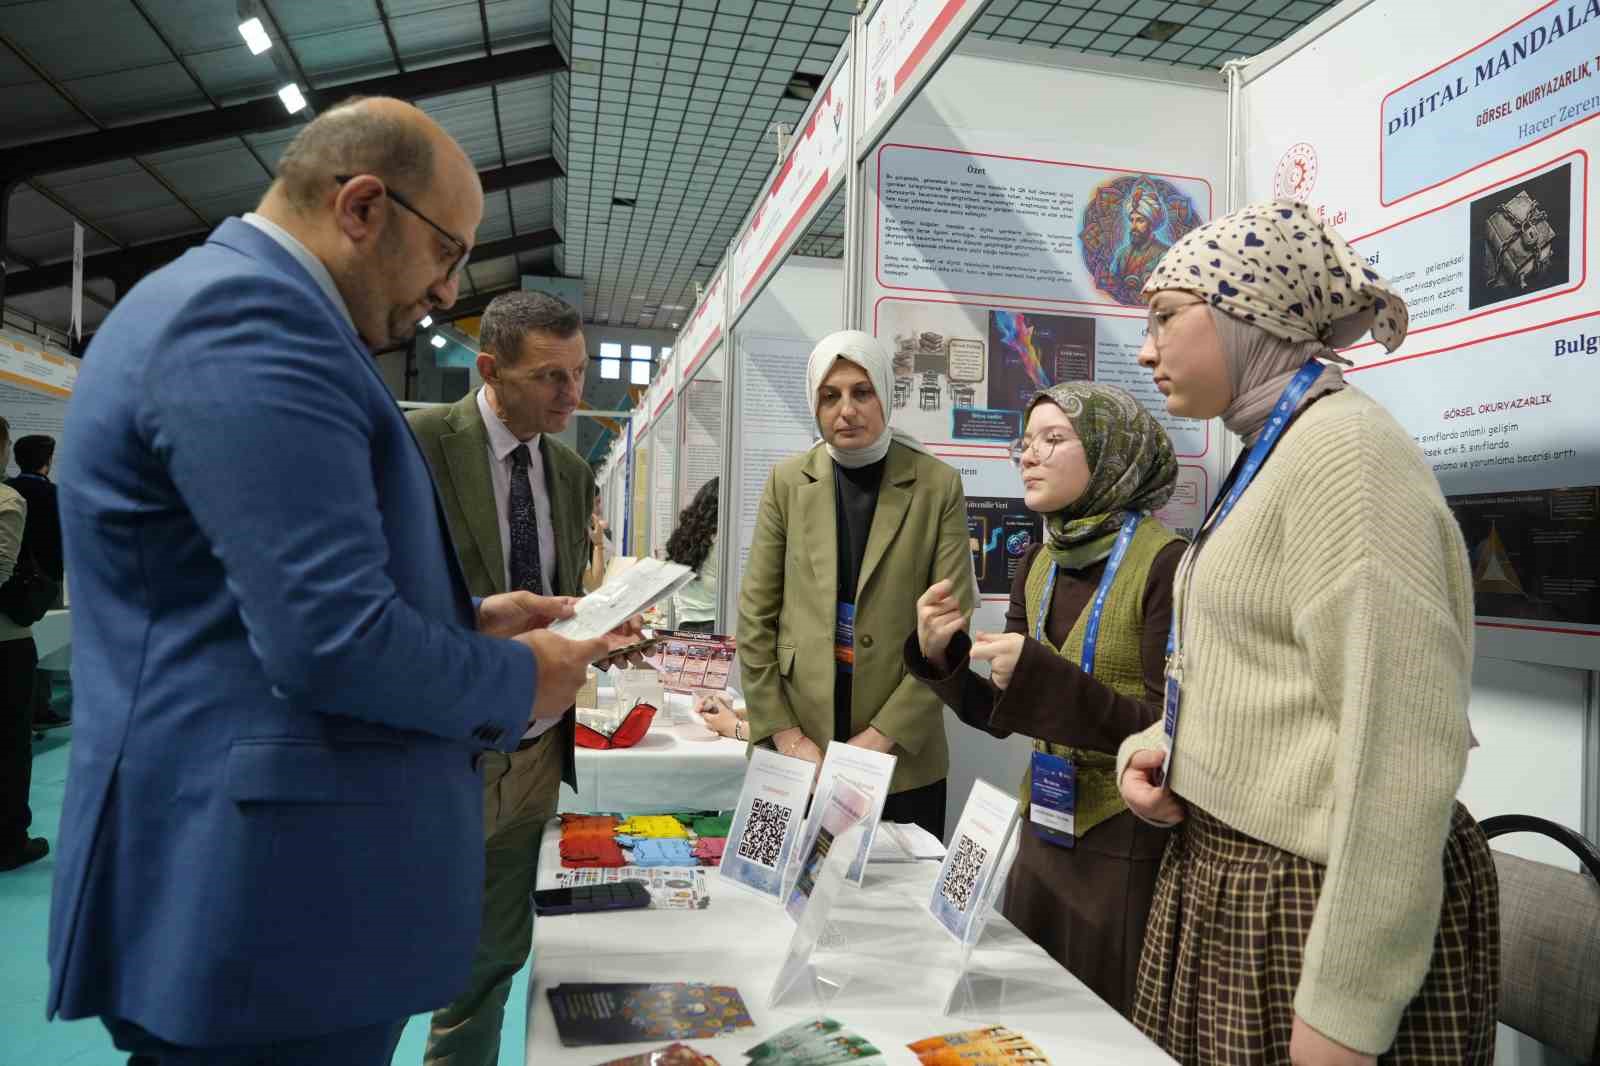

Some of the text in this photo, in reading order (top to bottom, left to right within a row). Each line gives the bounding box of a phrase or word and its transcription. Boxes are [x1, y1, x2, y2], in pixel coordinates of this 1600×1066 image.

[1388, 77, 1468, 136] DİJİTAL
[1476, 101, 1513, 128] GÖRSEL
[1515, 61, 1592, 110] OKURYAZARLIK,
[1518, 95, 1600, 139] Hacer Zeren
[1443, 393, 1552, 420] GÖRSEL OKURYAZARLIK
[1488, 423, 1519, 437] gelişim
